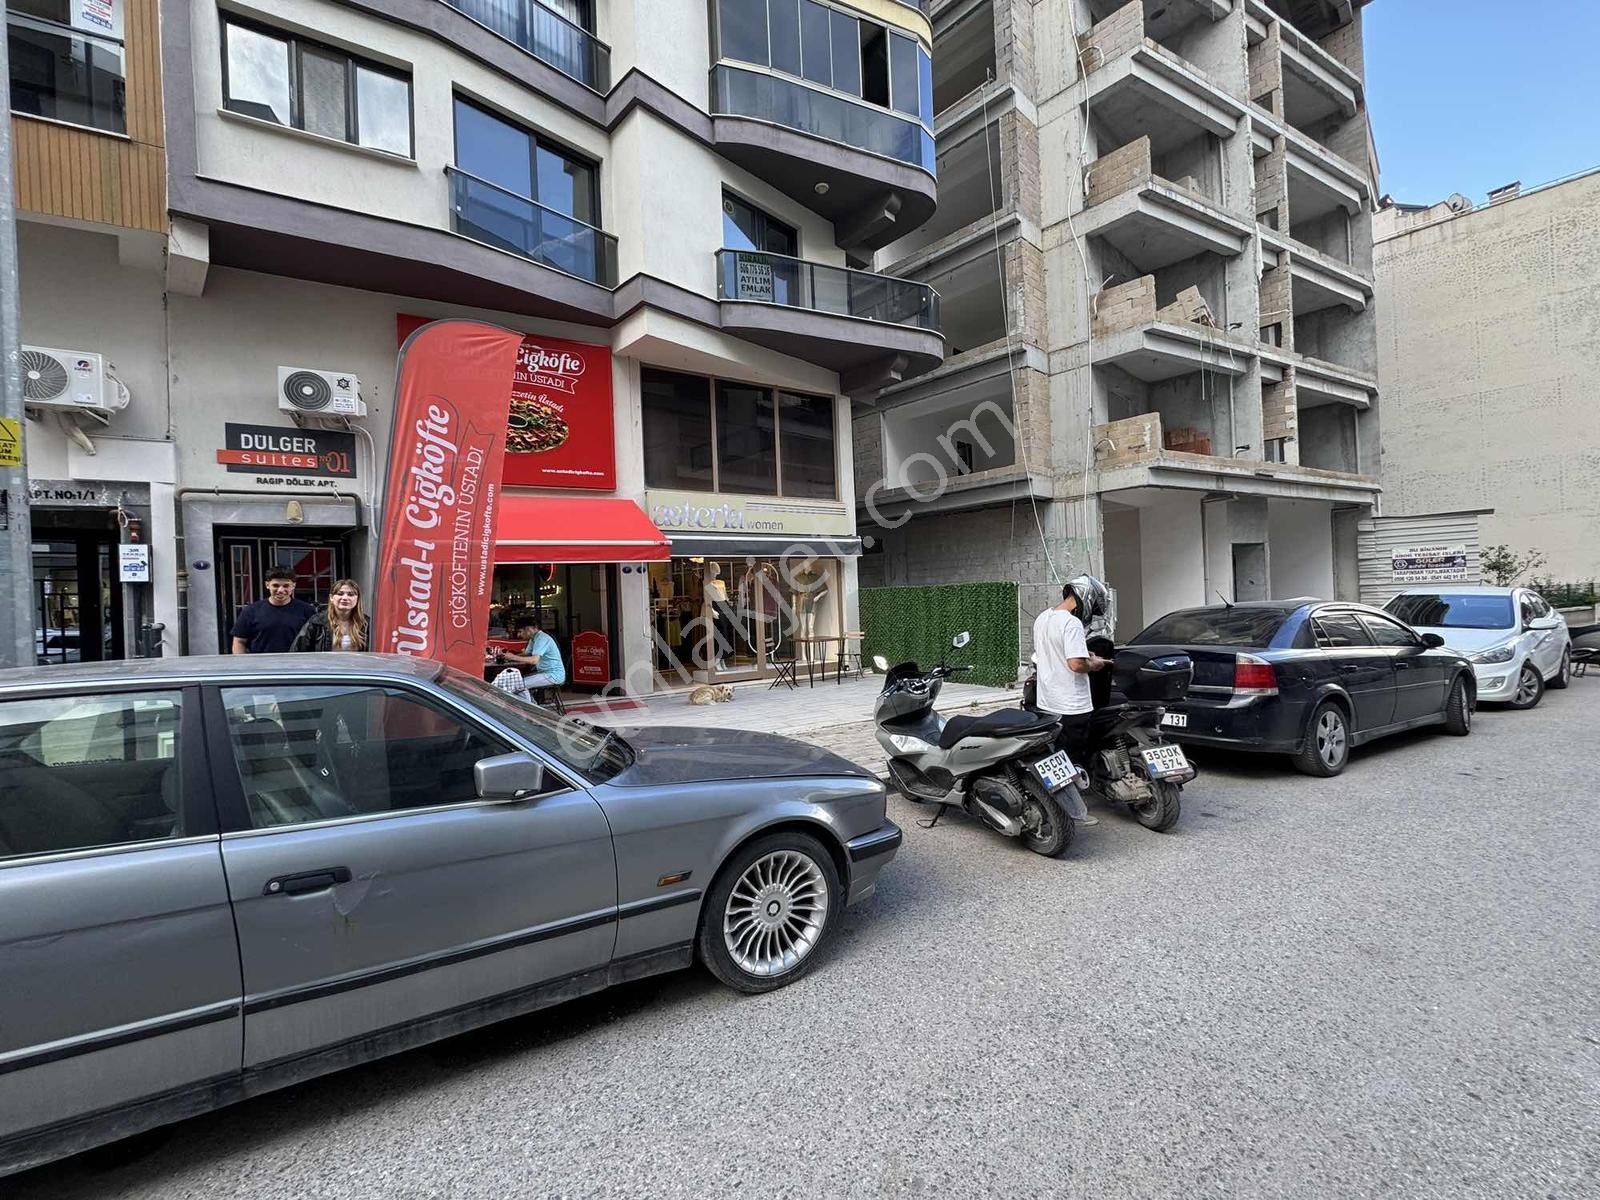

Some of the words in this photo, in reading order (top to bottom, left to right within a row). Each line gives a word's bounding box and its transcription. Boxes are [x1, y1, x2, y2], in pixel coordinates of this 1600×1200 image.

[740, 275, 771, 286] ATILIM
[741, 284, 771, 294] EMLAK
[240, 433, 316, 454] DÜLGER
[241, 453, 316, 467] suites
[405, 403, 458, 529] Çiğköfte
[746, 519, 784, 531] women
[1170, 714, 1186, 726] 131
[1162, 757, 1183, 770] 574
[1052, 766, 1072, 782] 531
